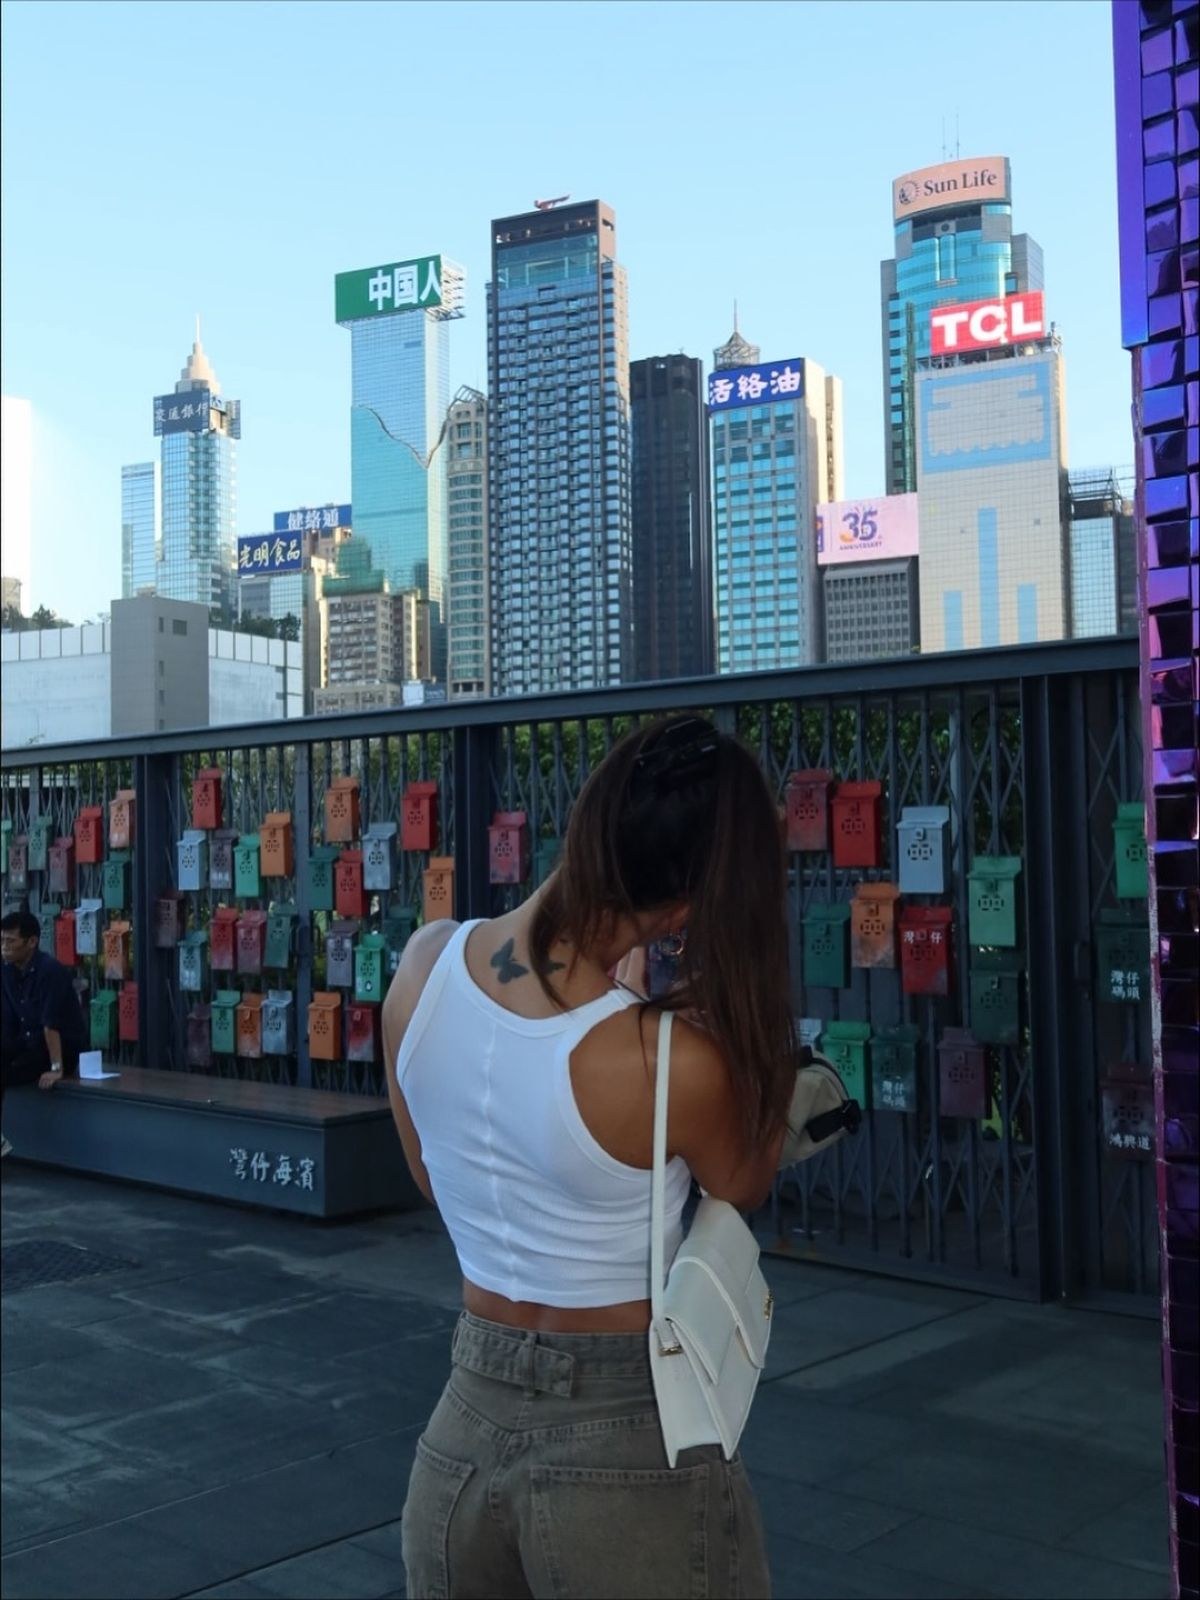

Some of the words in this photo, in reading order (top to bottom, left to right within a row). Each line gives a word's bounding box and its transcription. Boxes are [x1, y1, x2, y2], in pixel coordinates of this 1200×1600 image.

[923, 178, 958, 197] Sun
[962, 169, 997, 189] Life
[368, 260, 441, 311] 中国人
[932, 300, 1042, 347] TCL
[709, 366, 801, 406] 活絡油
[840, 509, 878, 543] 35
[239, 537, 301, 568] 光明食品
